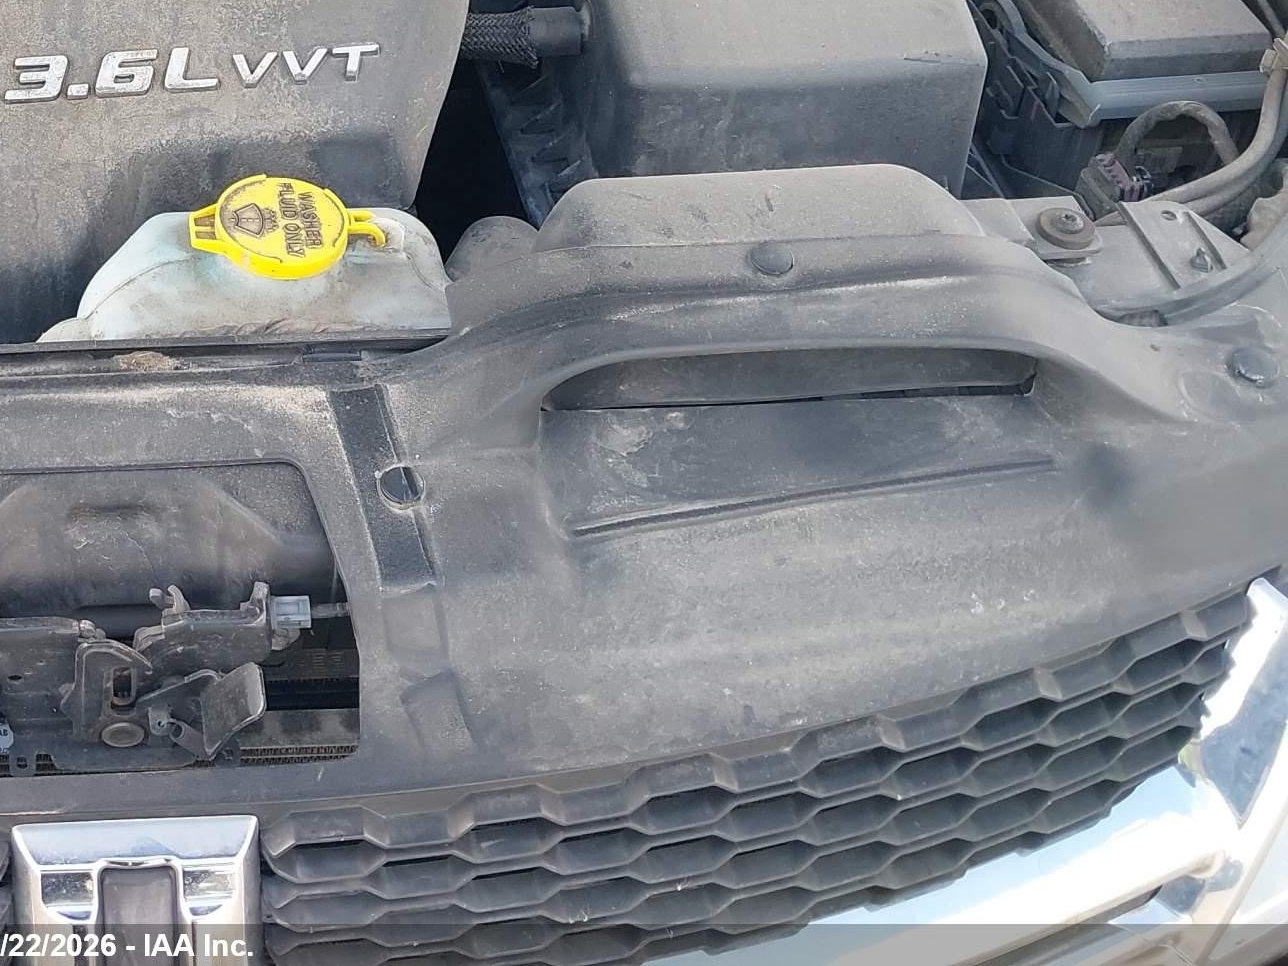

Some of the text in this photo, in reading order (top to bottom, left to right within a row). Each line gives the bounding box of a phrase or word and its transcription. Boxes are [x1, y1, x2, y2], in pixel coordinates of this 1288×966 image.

[4, 44, 381, 104] 3.6L VVT
[278, 182, 306, 257] FLUID ONLY
[298, 191, 323, 249] WASHER
